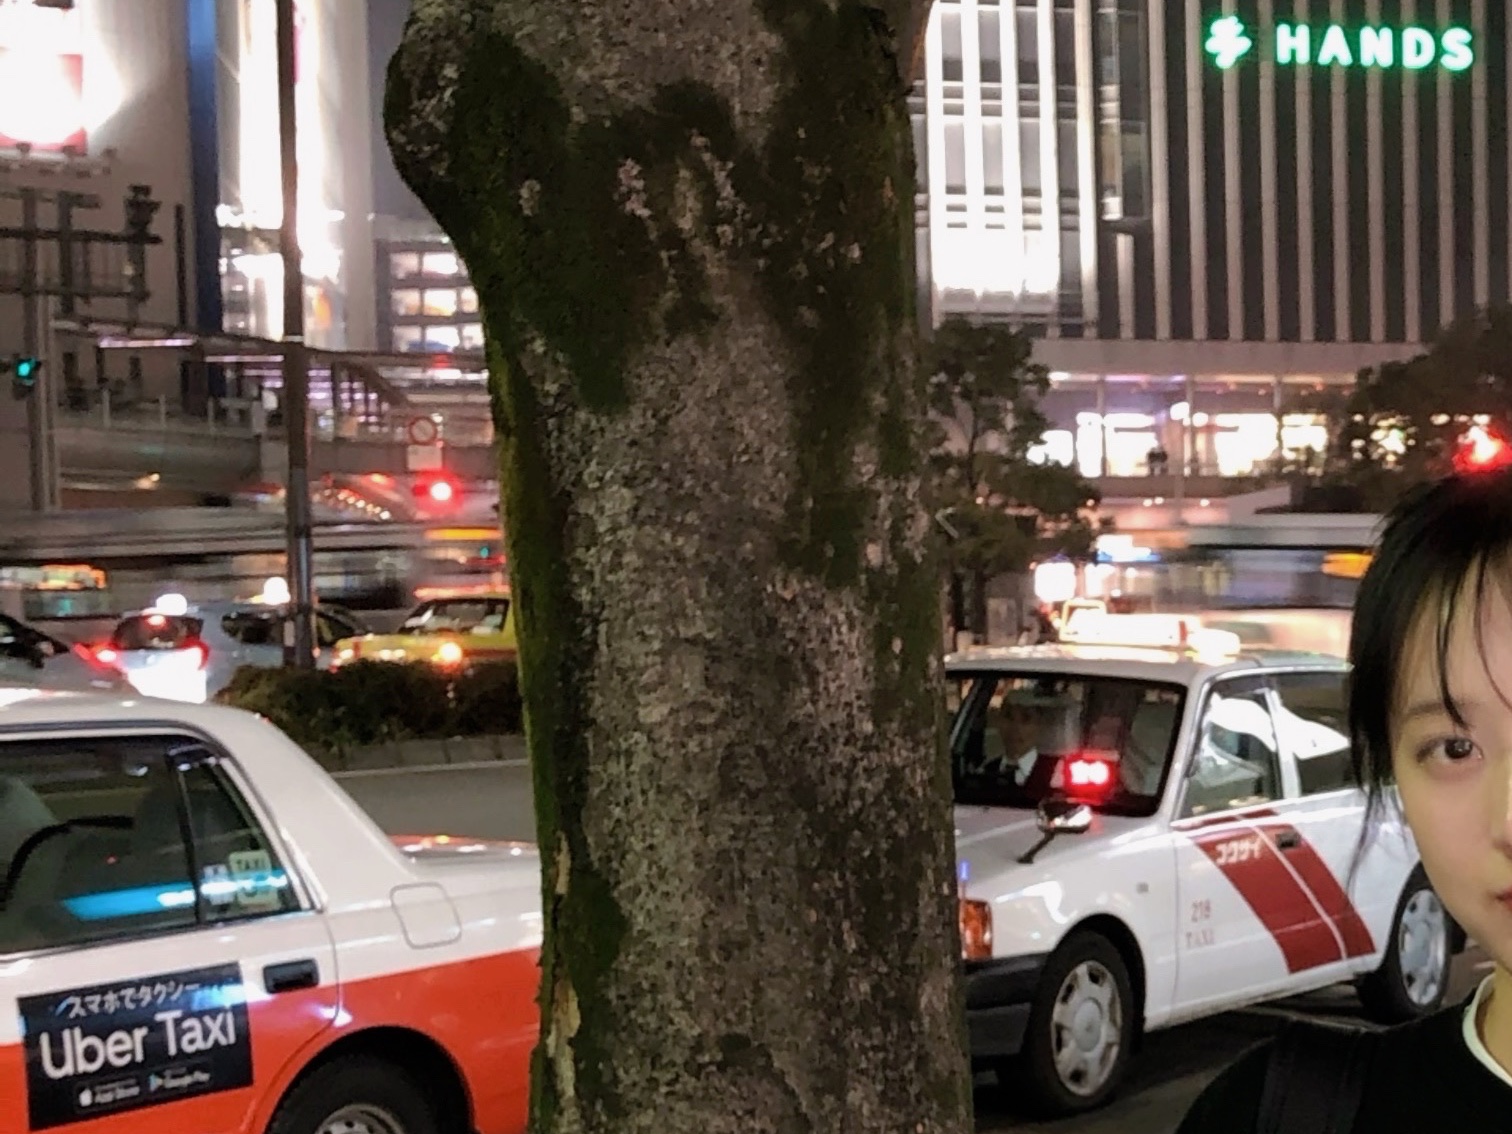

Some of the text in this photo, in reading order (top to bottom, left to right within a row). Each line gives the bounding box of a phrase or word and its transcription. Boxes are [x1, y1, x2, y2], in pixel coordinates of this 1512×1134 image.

[1275, 22, 1474, 71] HANDS
[39, 1010, 235, 1079] Uber Taxi
